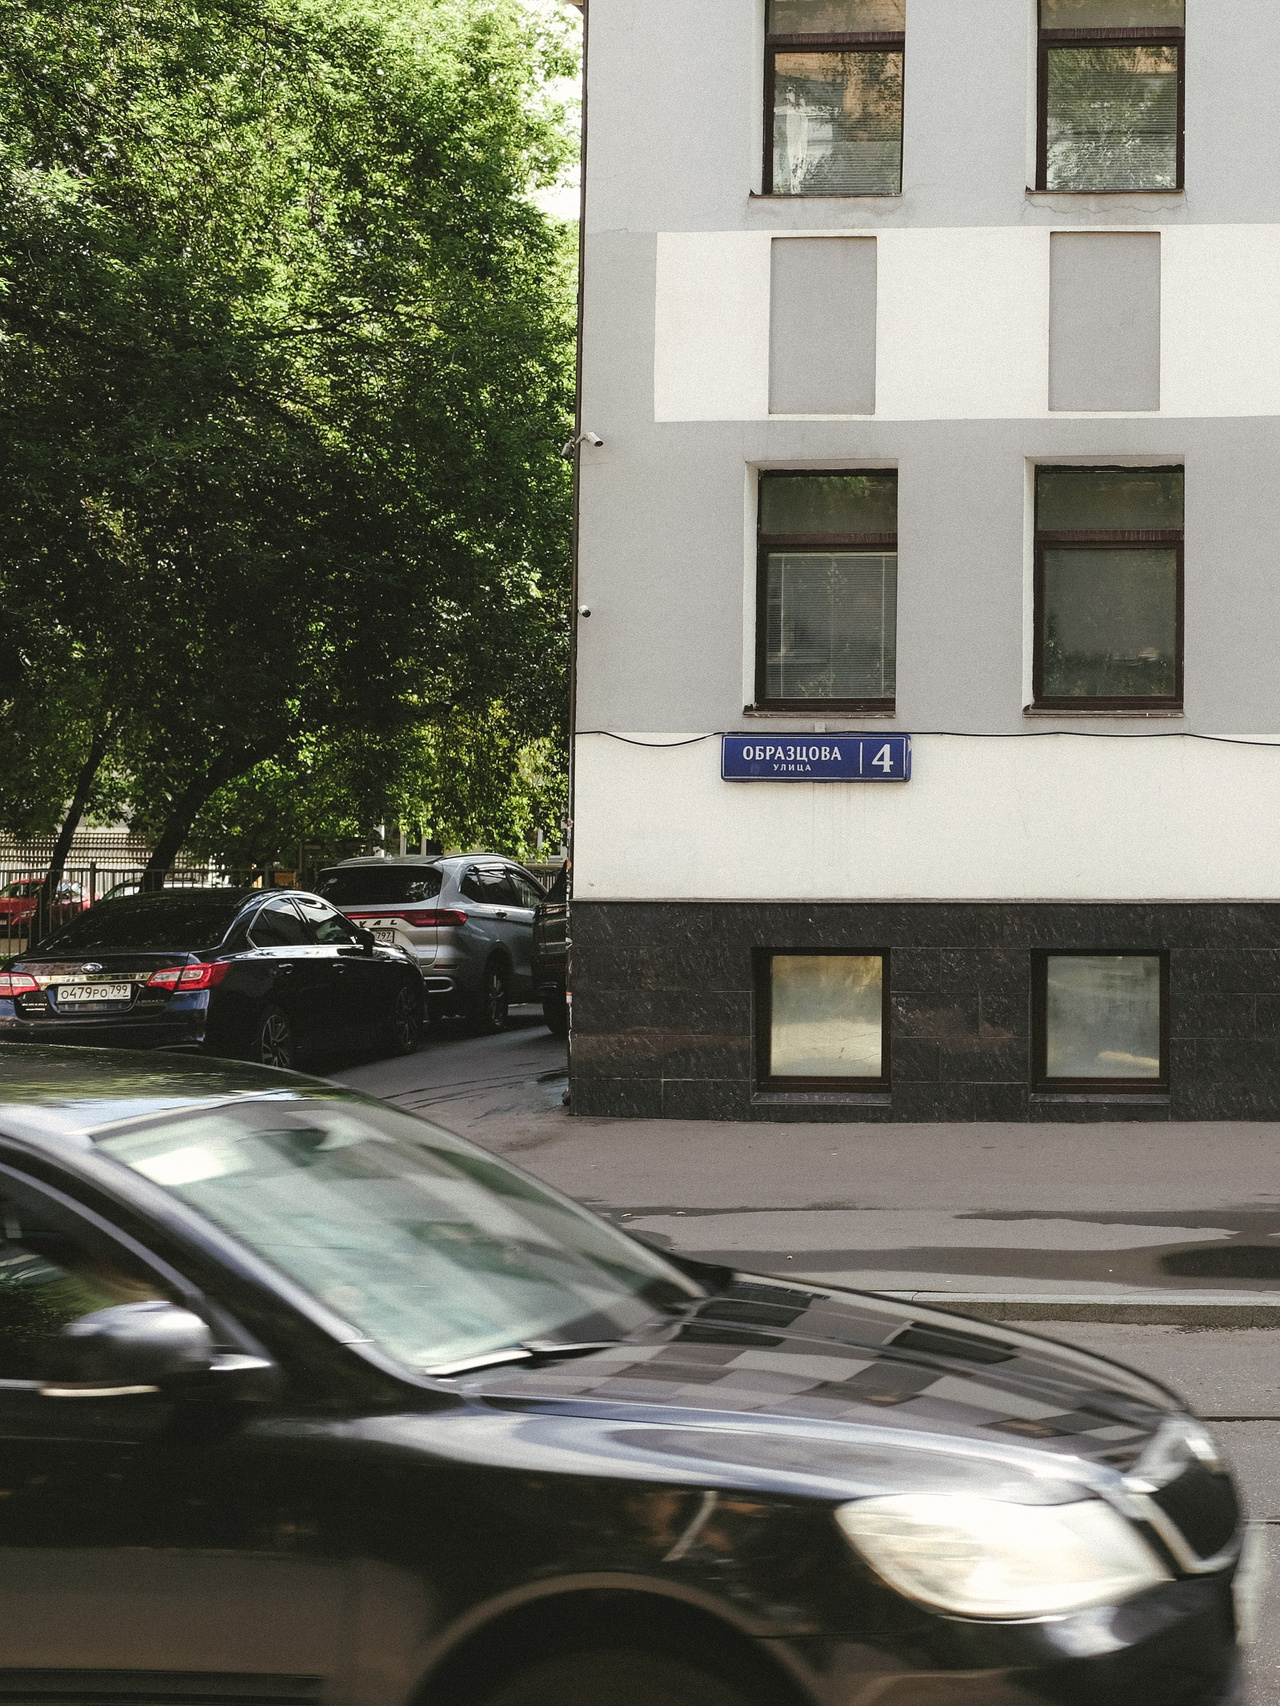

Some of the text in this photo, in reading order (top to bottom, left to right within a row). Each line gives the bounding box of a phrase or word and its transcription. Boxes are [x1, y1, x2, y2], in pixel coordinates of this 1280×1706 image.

[742, 746, 842, 763] ОБРАЗЦОВА
[871, 743, 894, 773] 4
[773, 763, 812, 772] УЛИЦА
[359, 920, 397, 928] VAL
[110, 985, 128, 995] 799
